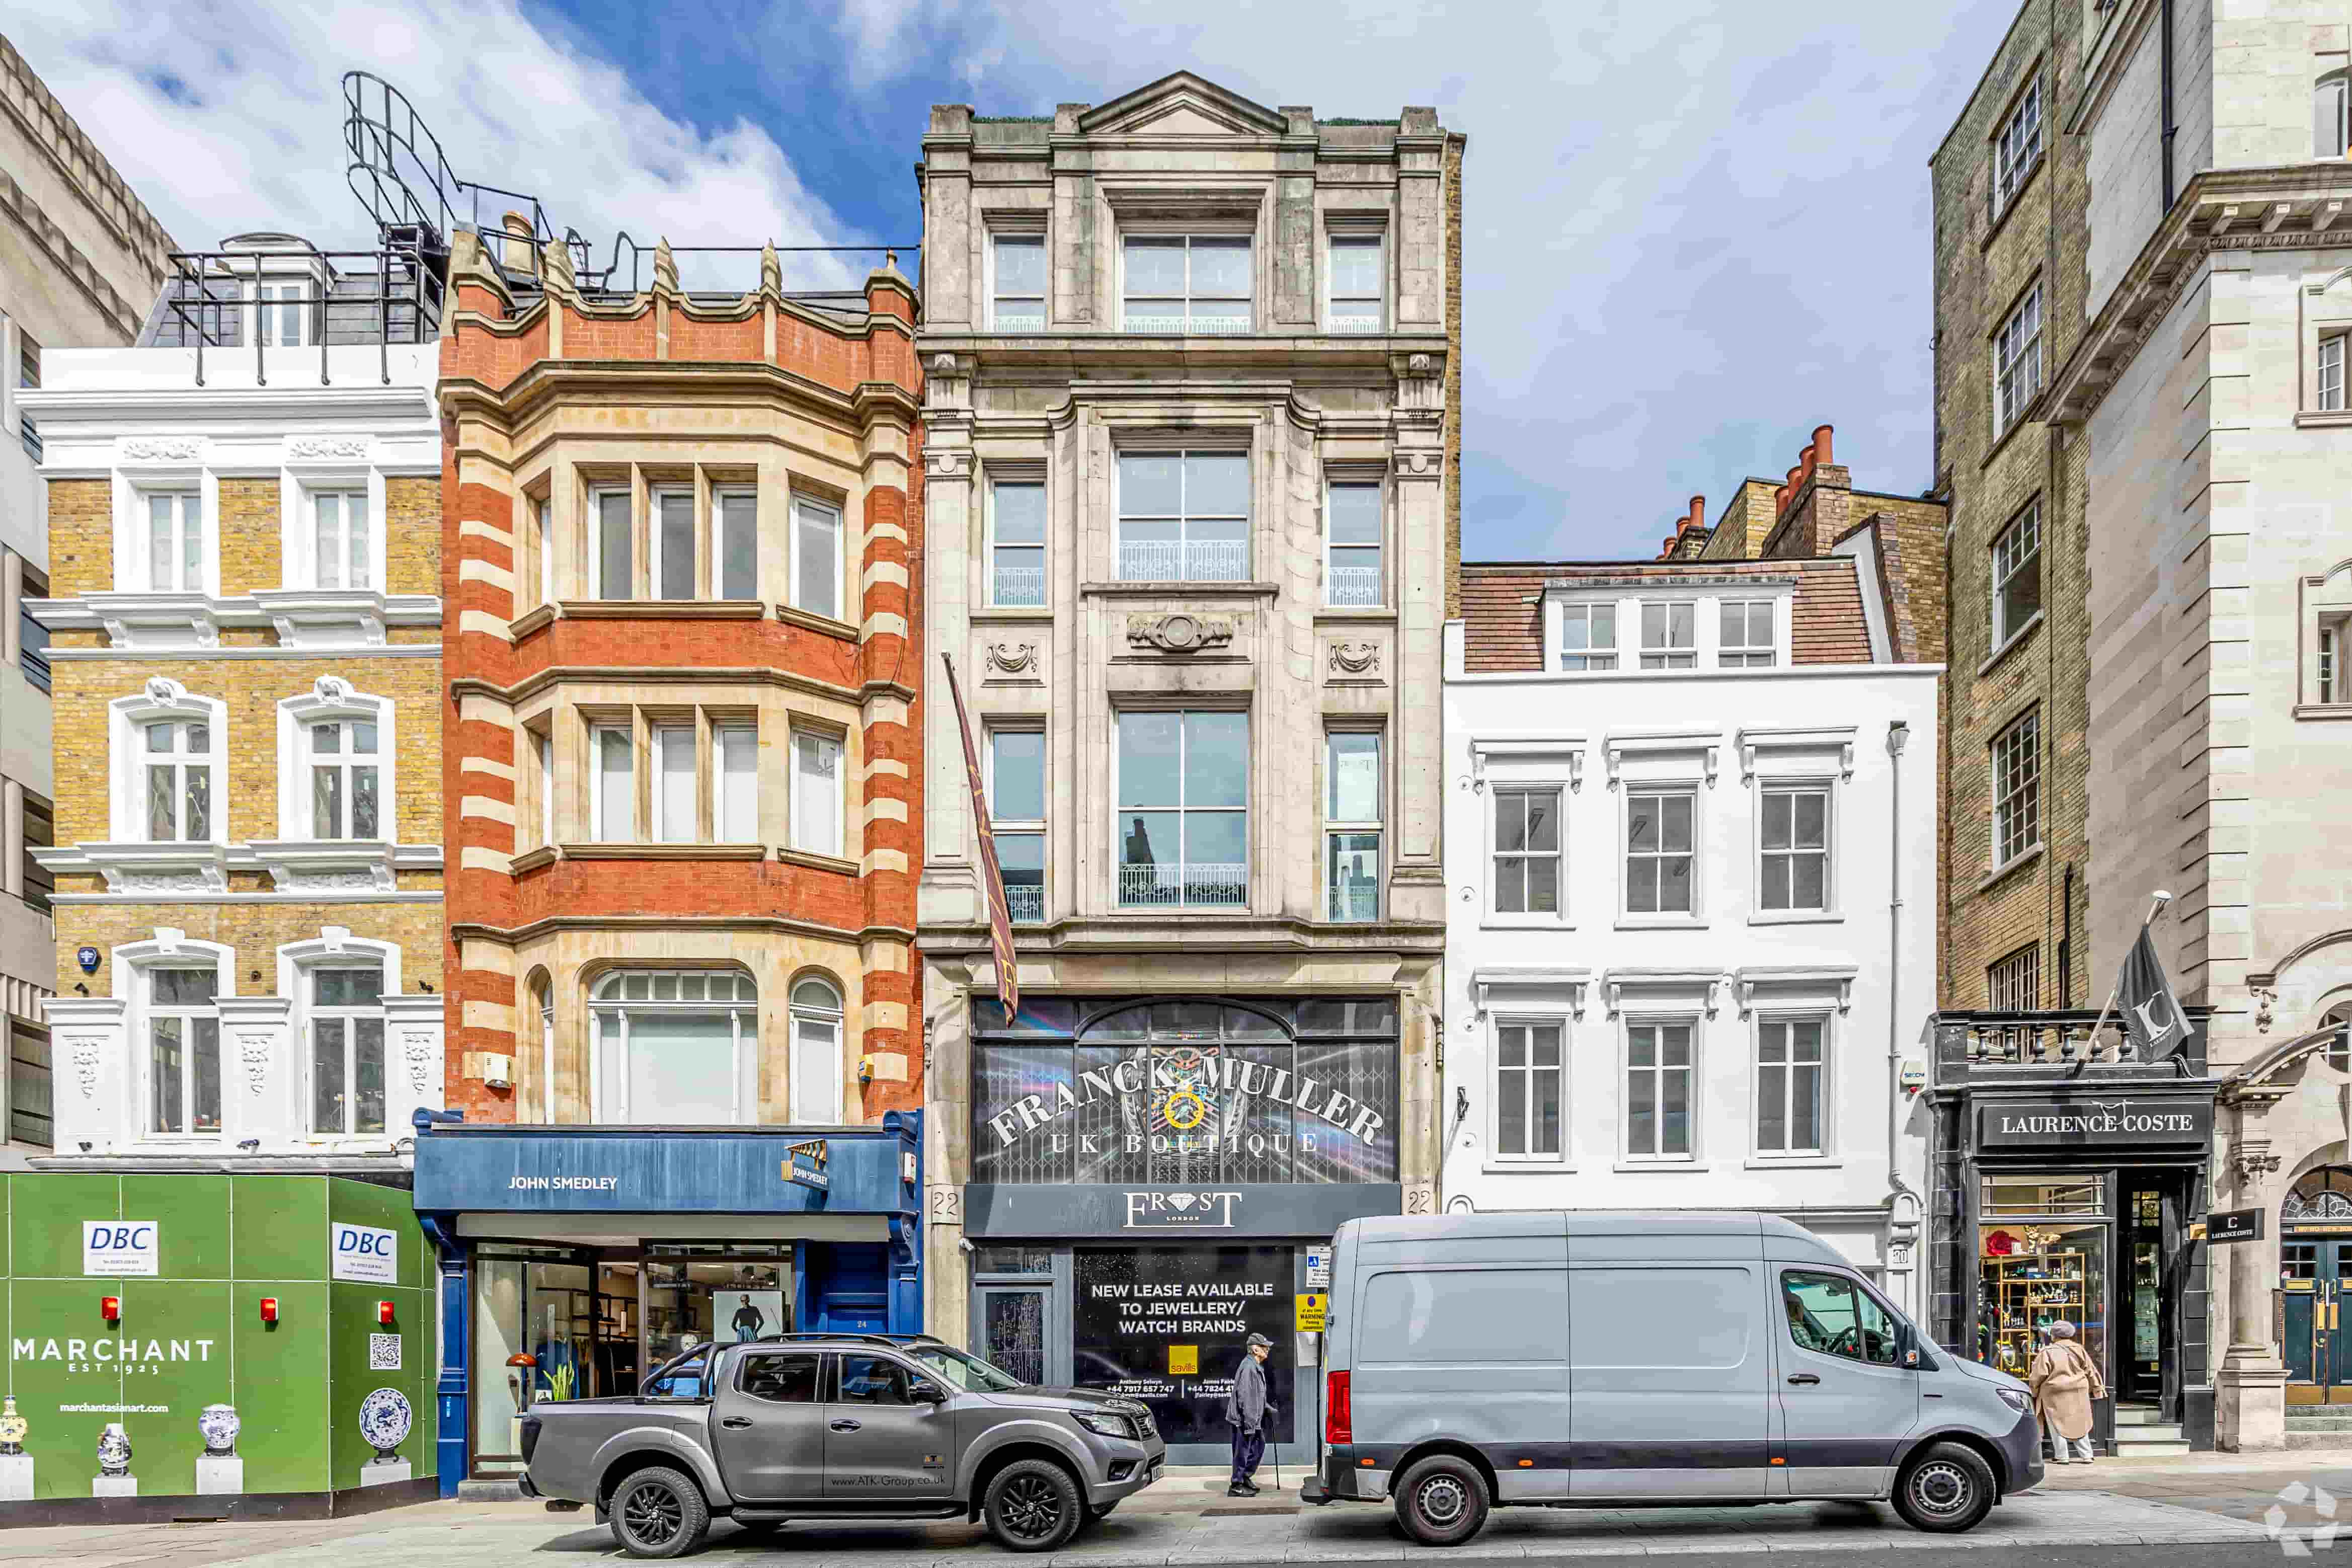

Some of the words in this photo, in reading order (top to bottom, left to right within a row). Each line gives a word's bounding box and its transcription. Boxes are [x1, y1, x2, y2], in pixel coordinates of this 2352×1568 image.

[987, 1057, 1176, 1148] FRANCK
[1196, 1056, 1383, 1147] MULLER
[2001, 1116, 2117, 1133] LAURENCE
[2123, 1115, 2193, 1132] COSTE
[1050, 1134, 1099, 1153] UK
[1125, 1133, 1317, 1158] BOUTIQUE
[508, 1177, 549, 1189] JOHN
[552, 1177, 618, 1190] SMEDLEY
[933, 1192, 959, 1215] 22
[1408, 1190, 1430, 1214] 22
[90, 1227, 151, 1250] DBC
[338, 1230, 392, 1256] DBC
[1091, 1284, 1129, 1297] NEW
[1134, 1284, 1183, 1297] LEASE
[1187, 1284, 1274, 1296] AVAILABLE
[1120, 1303, 1142, 1315] TO
[1146, 1300, 1246, 1316] JEWELLERY/
[1119, 1320, 1178, 1334] WATCH
[1182, 1320, 1246, 1333] BRANDS
[13, 1339, 214, 1361] MARCHANT
[68, 1363, 104, 1372] EST
[113, 1364, 159, 1375] 1925
[1170, 1363, 1197, 1373] savills
[59, 1402, 169, 1413] marchantasianart.com
